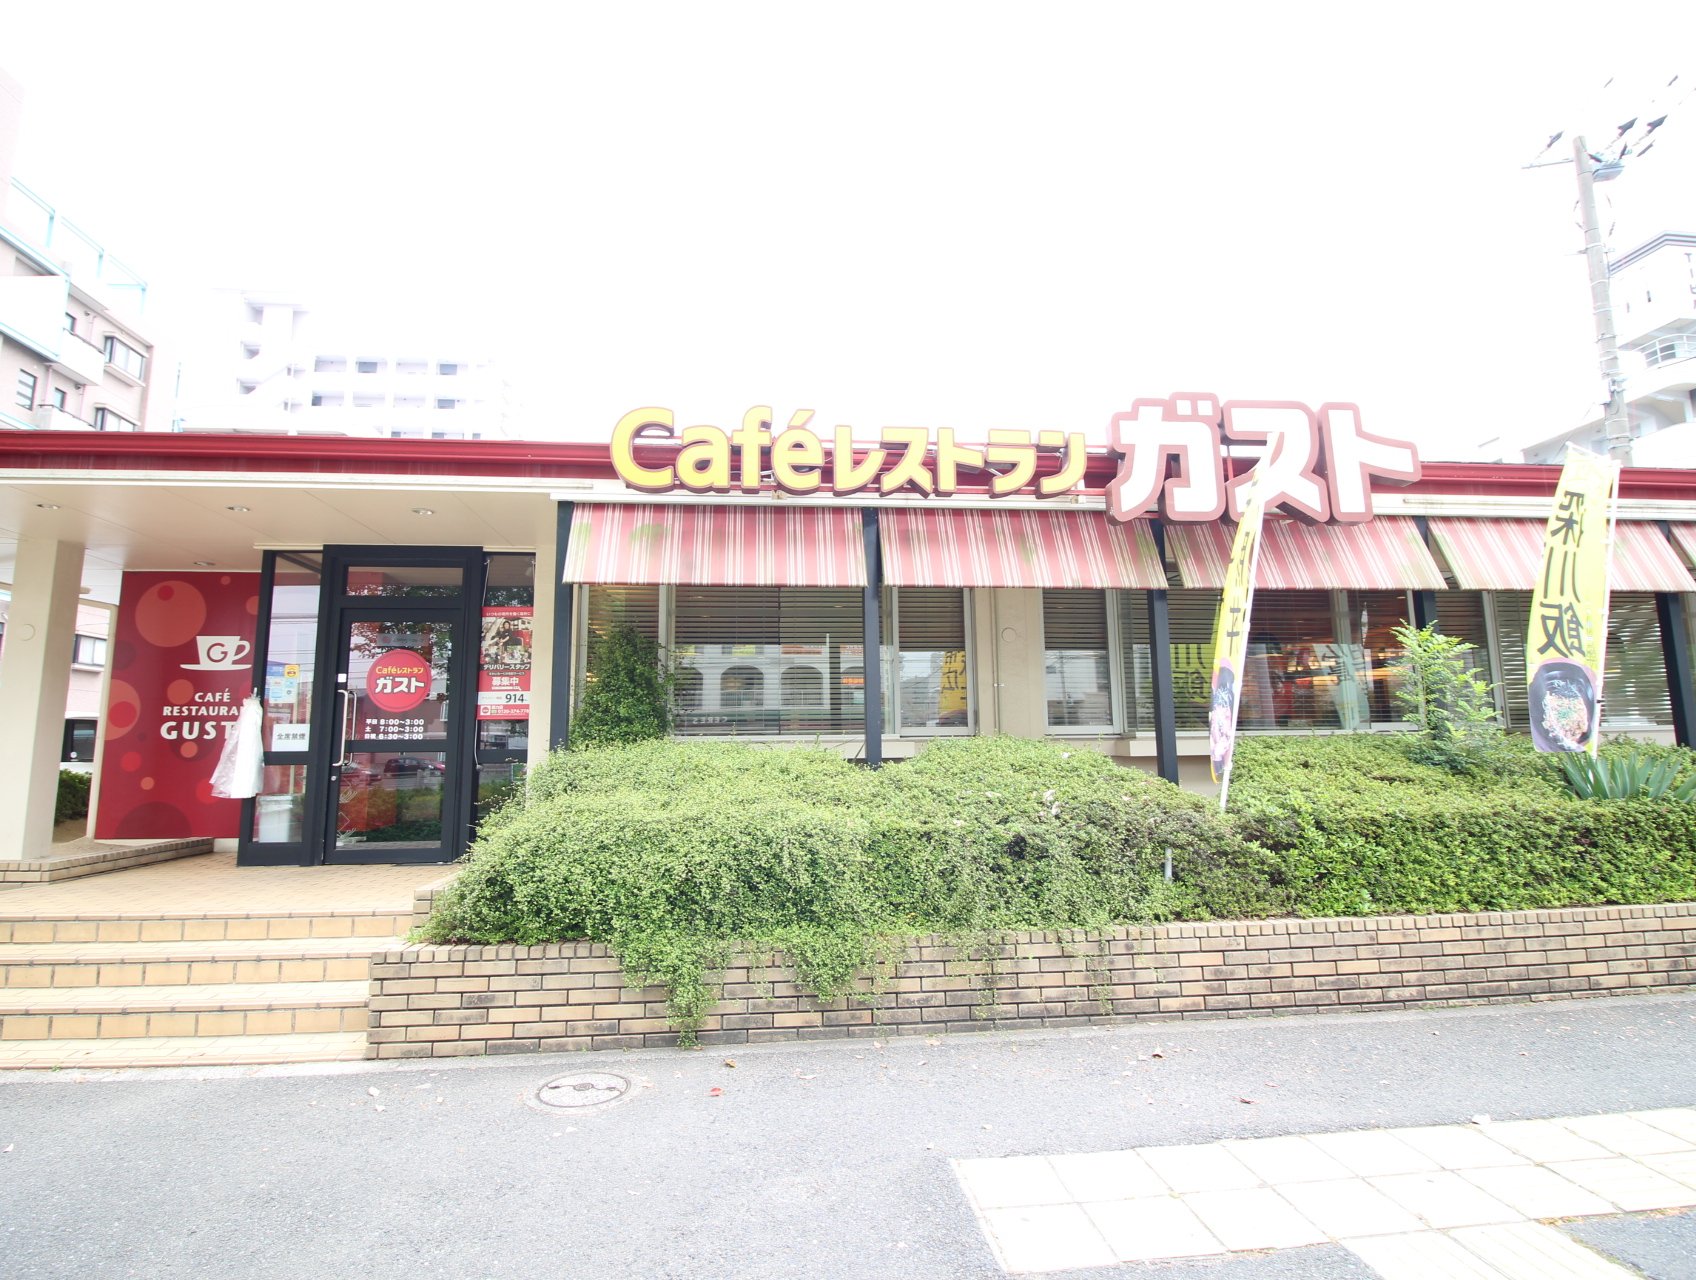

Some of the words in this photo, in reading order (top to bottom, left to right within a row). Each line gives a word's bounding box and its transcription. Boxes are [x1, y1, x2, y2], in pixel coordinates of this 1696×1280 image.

[610, 405, 1087, 496] Caféレストラン
[1105, 391, 1422, 524] ガスト
[207, 643, 228, 663] G
[375, 666, 424, 675] Caféレストラン
[374, 676, 425, 694] ガスト
[194, 688, 231, 703] CAFÉ
[505, 693, 525, 703] 914
[162, 705, 240, 716] RESTAURA
[160, 721, 236, 740] GUST
